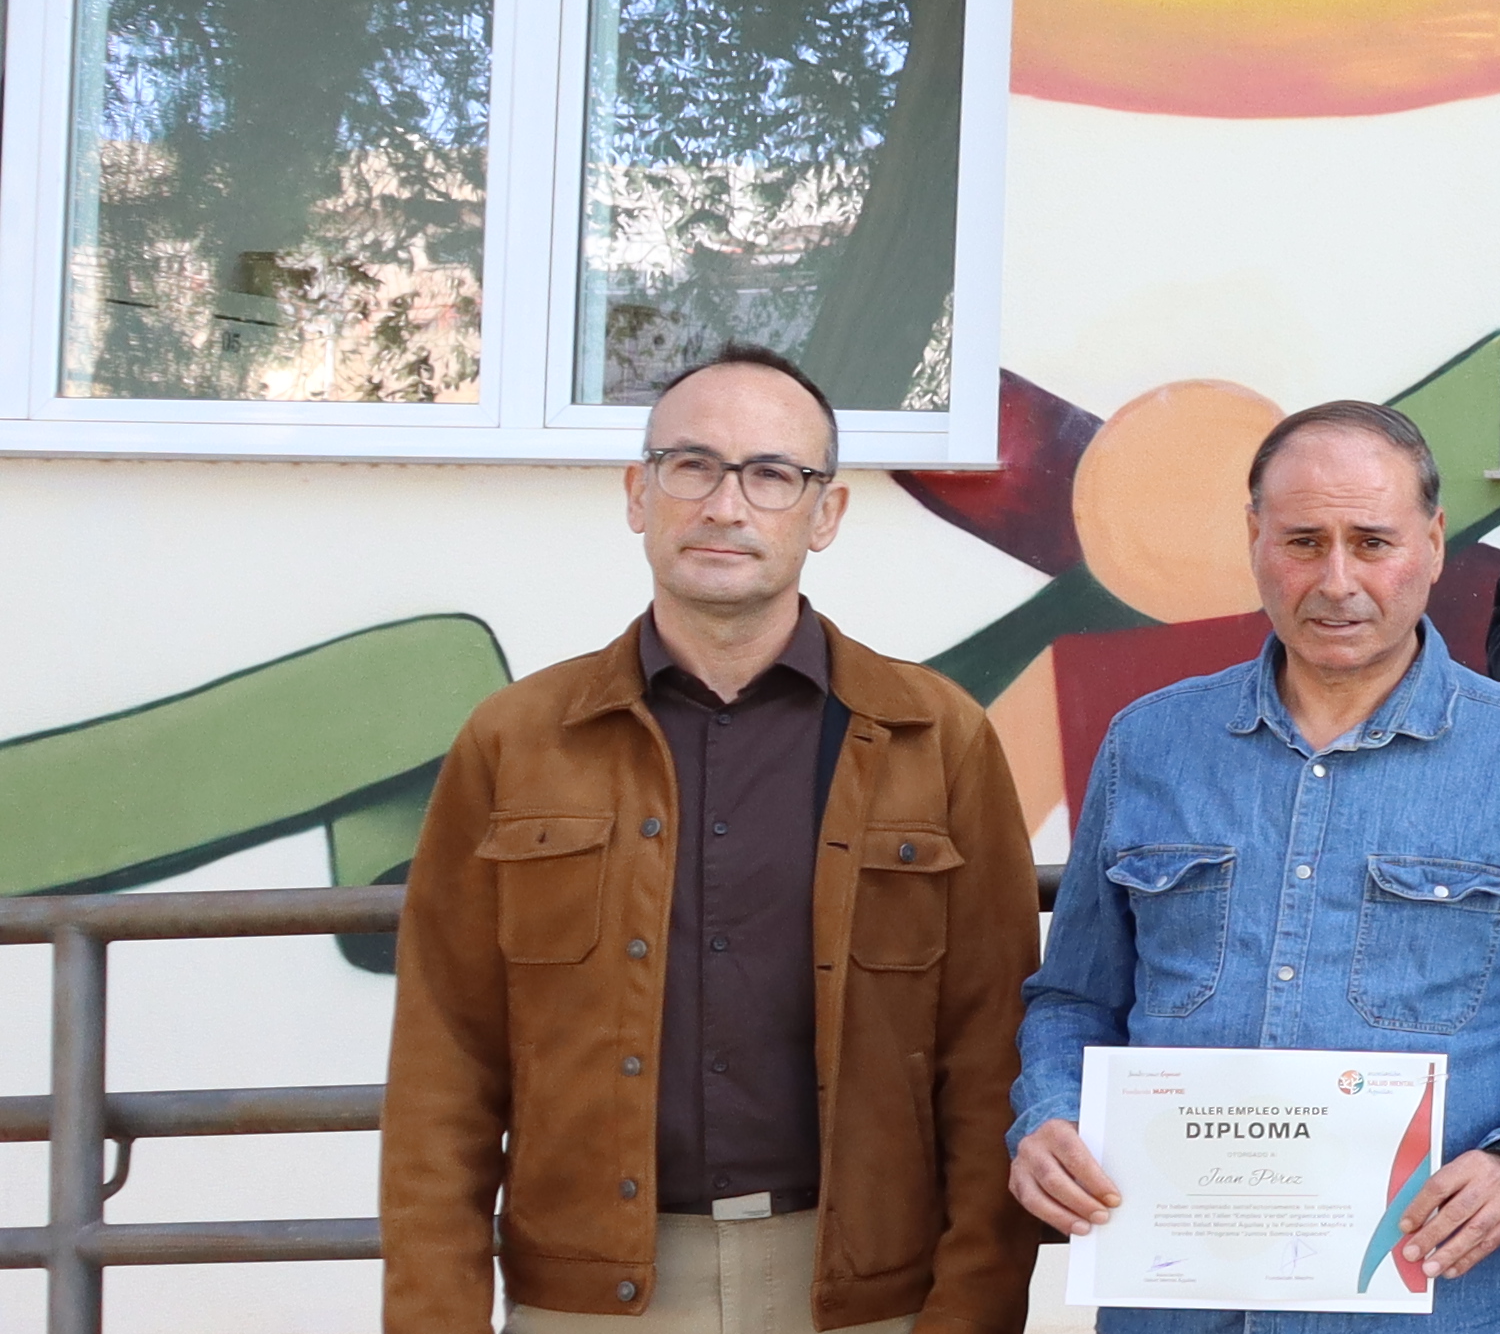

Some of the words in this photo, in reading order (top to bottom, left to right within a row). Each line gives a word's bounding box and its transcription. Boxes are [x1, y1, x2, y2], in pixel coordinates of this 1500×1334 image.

[1178, 1106, 1223, 1116] TALLER
[1227, 1106, 1280, 1116] EMPLEO
[1284, 1106, 1329, 1116] VERDE
[1186, 1122, 1311, 1139] DIPLOMA
